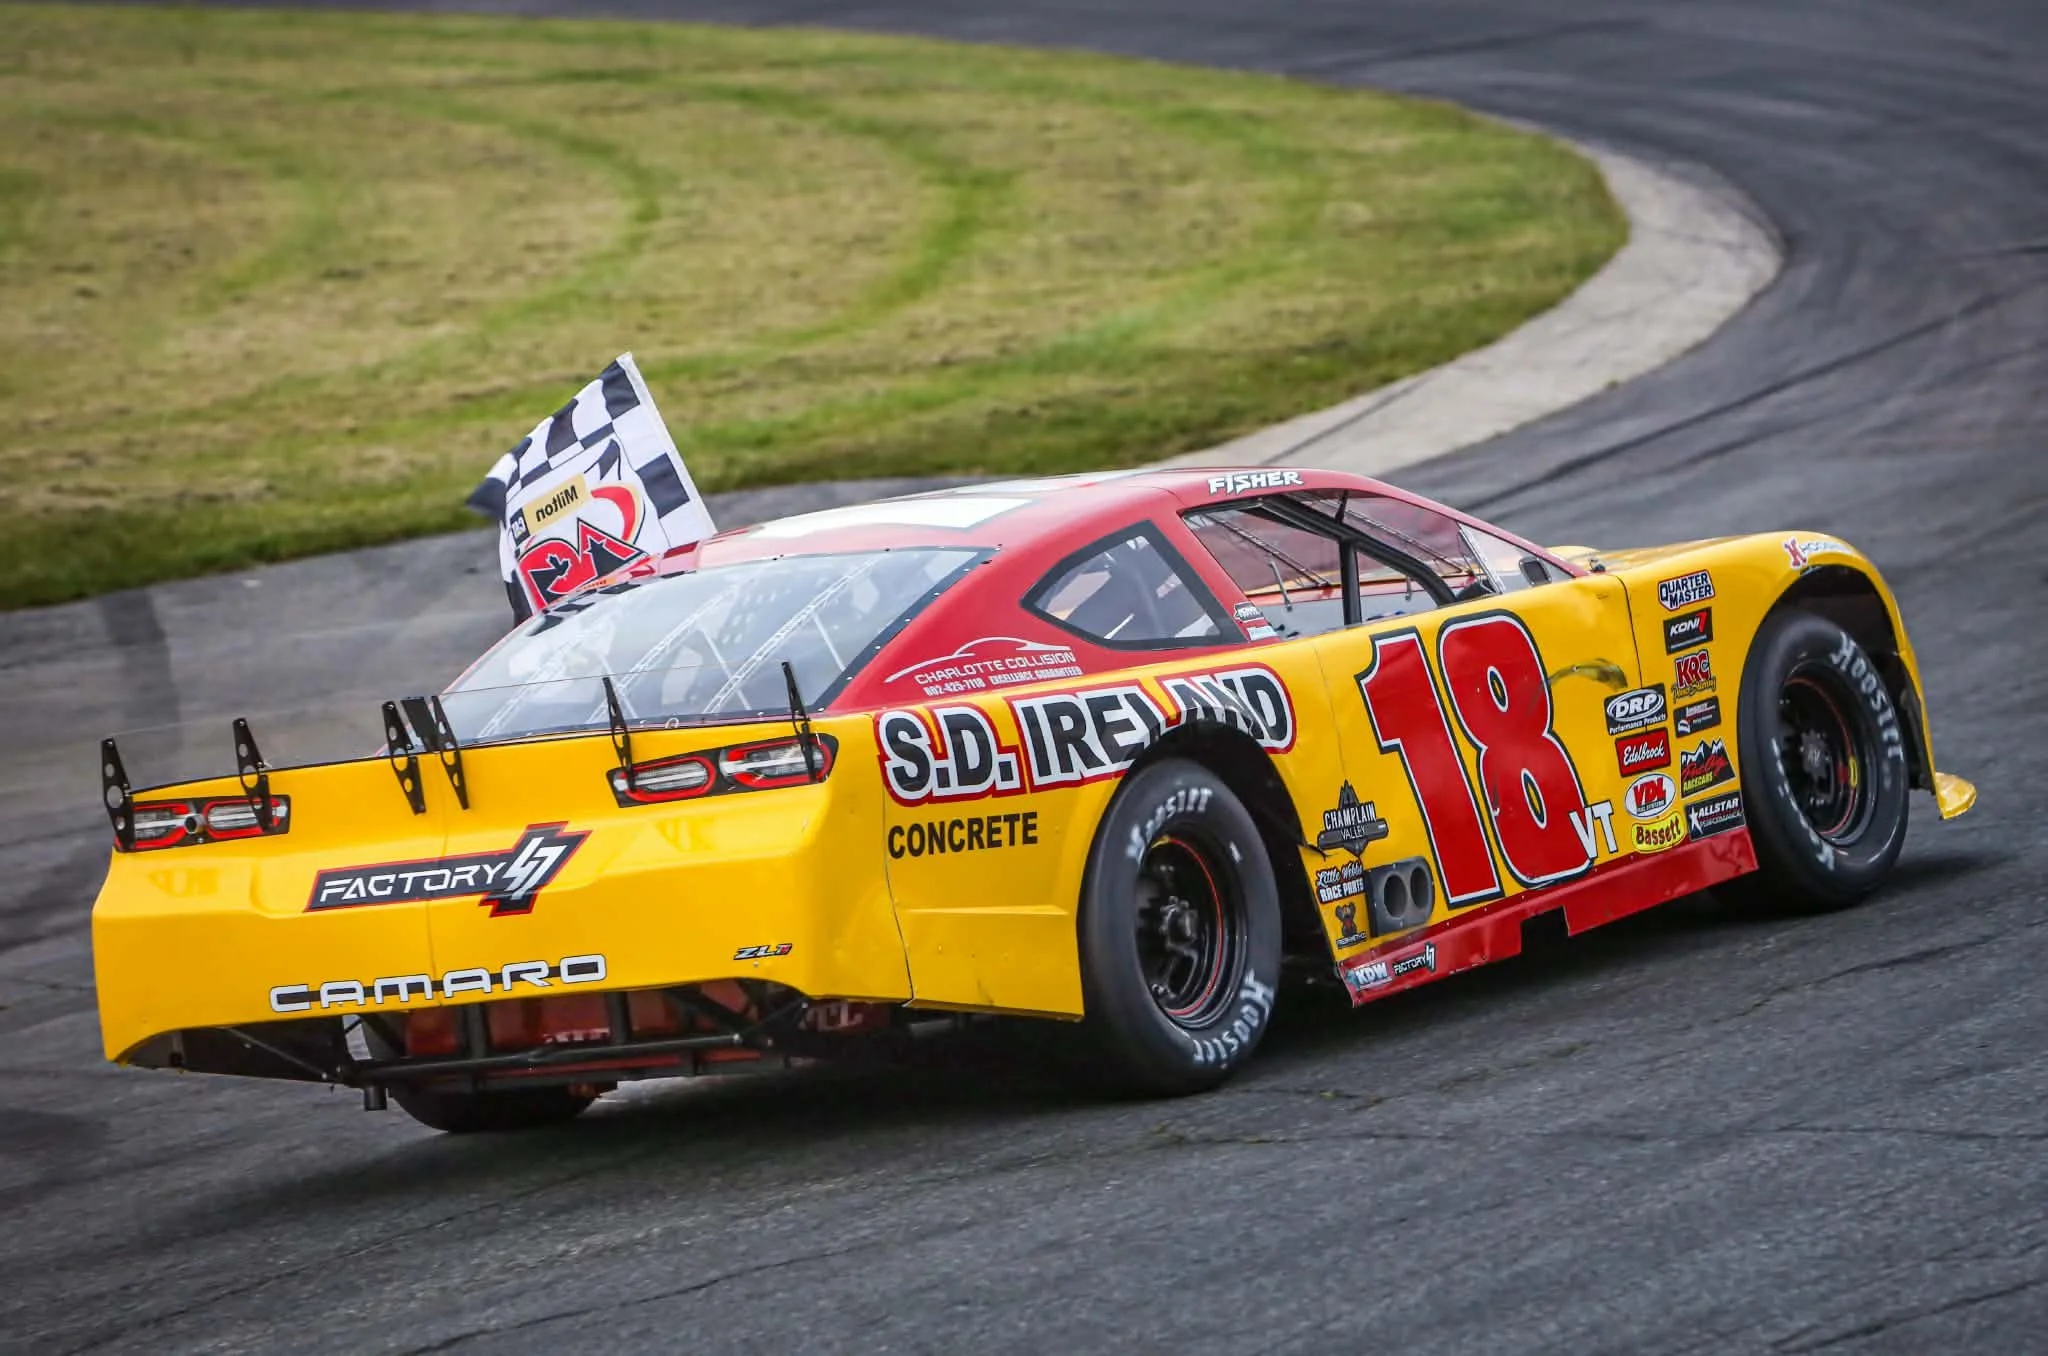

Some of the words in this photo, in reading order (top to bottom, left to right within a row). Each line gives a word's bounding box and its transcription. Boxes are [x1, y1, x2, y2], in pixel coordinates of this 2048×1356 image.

[1207, 471, 1304, 496] FISHER
[1659, 572, 1709, 602] QUARTER
[1669, 583, 1713, 609] MASTER
[1669, 617, 1701, 637] KONI
[914, 659, 1003, 685] CHARLOTTE
[1005, 651, 1077, 669] COLLISION
[1675, 650, 1711, 689] KRC
[1616, 692, 1659, 718] DRP
[881, 709, 1017, 796] S.D.
[1019, 671, 1292, 780] IRELAND
[1609, 720, 1644, 735] Performance
[1644, 713, 1666, 726] Products
[1356, 612, 1593, 907] 18
[1623, 740, 1665, 766] Edelbrock
[1633, 777, 1667, 807] VDL
[1324, 802, 1377, 830] CHAMPLAIN
[1698, 797, 1740, 818] ALLSTAR
[888, 811, 1038, 859] CONCRETE
[1341, 825, 1366, 840] VALLEY
[1569, 800, 1619, 860] VT
[1636, 815, 1681, 845] Bassett
[319, 861, 507, 902] FACTORY
[1320, 884, 1343, 903] RACE
[1342, 878, 1364, 897] PARTS
[1355, 961, 1388, 985] KDW
[1393, 953, 1427, 975] FACTORY
[268, 952, 608, 1013] CAMARO
